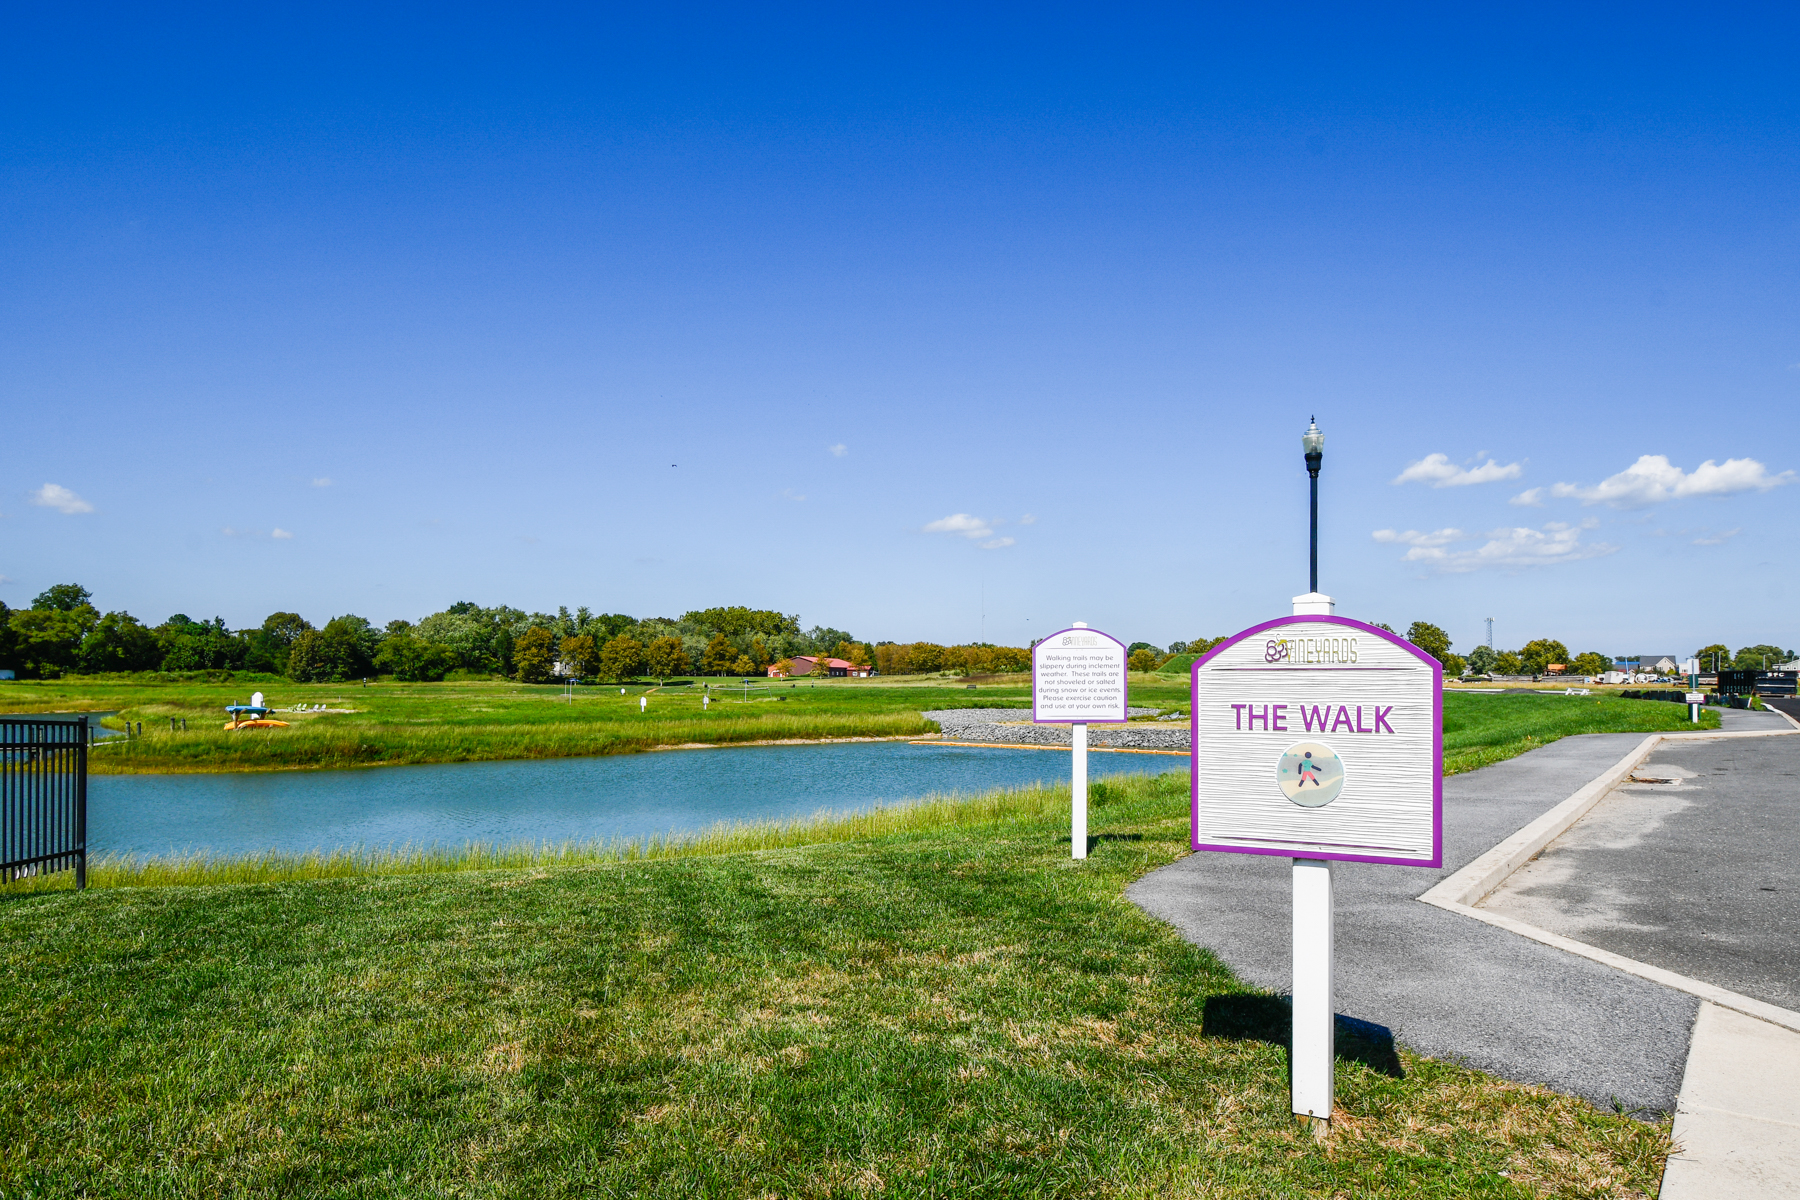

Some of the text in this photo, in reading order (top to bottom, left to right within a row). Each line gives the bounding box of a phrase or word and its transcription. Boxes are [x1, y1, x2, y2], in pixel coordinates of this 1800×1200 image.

[1286, 638, 1358, 663] VINEYARDS
[1231, 704, 1395, 734] THE WALK
